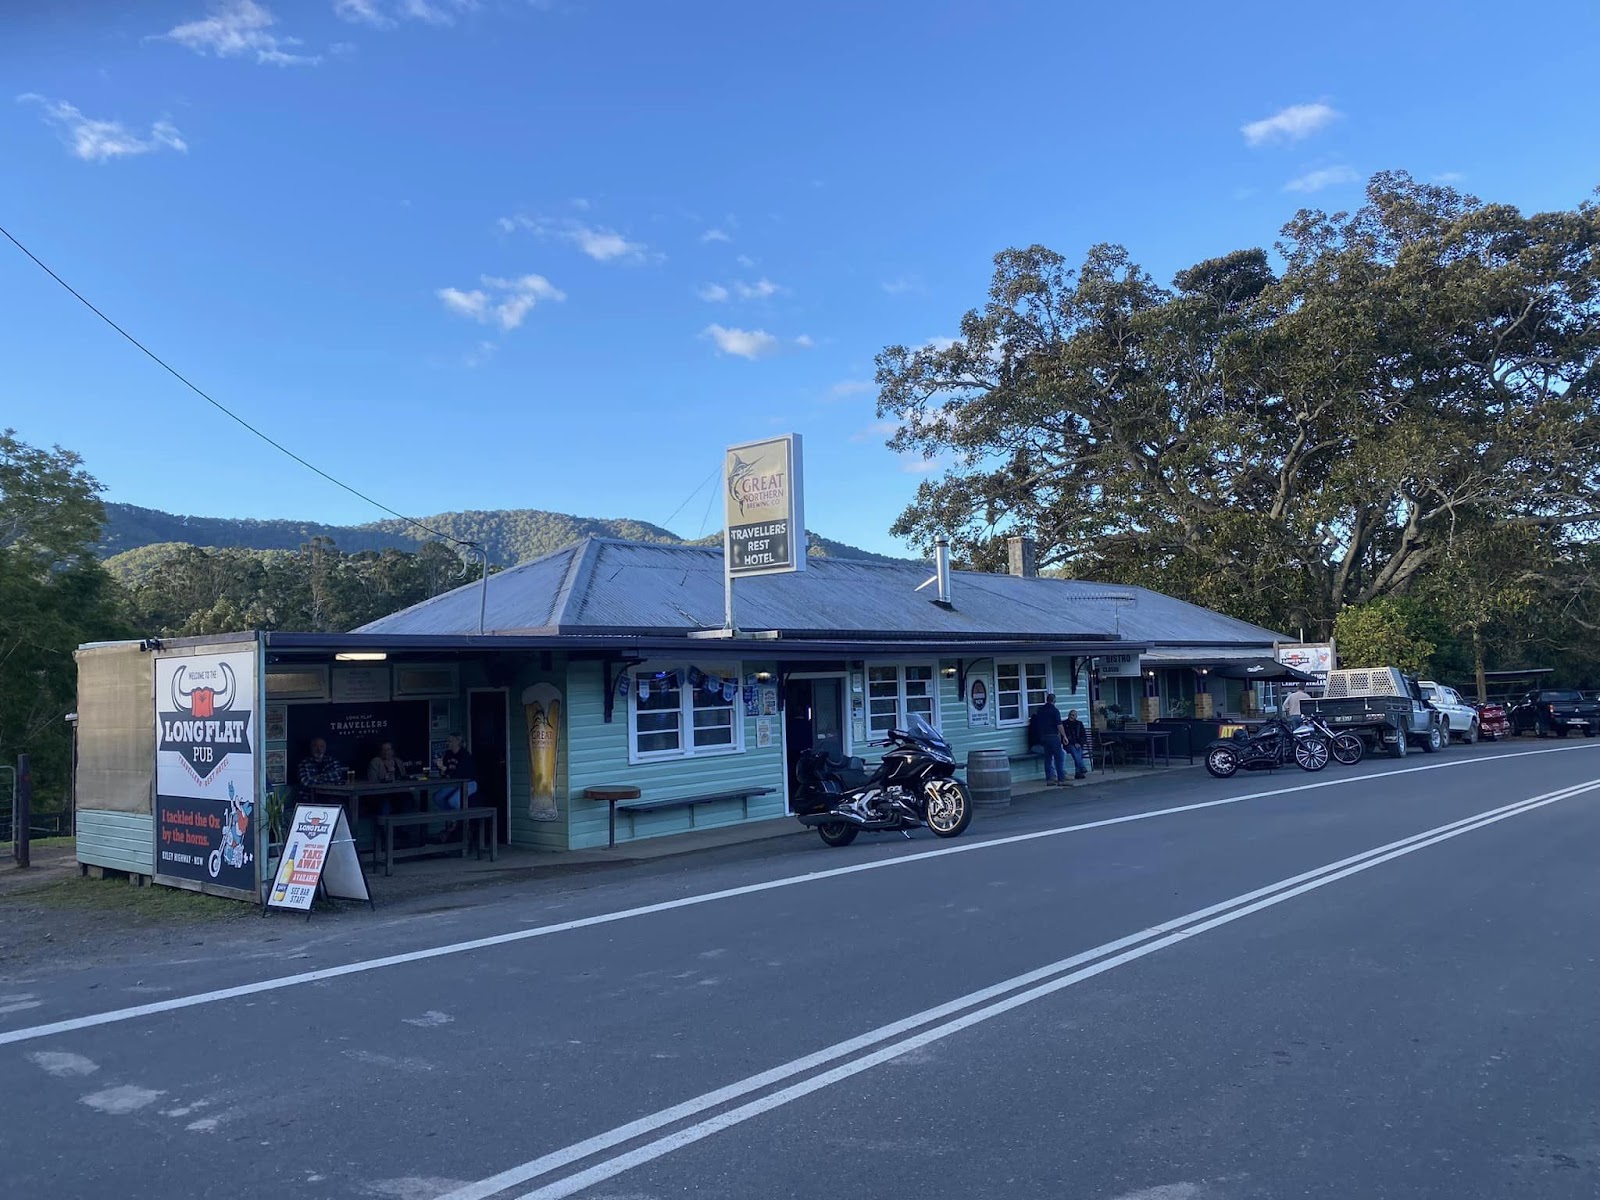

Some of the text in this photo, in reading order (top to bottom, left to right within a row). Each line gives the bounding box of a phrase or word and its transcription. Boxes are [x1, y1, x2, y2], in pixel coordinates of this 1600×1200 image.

[742, 473, 784, 494] GREAT
[743, 489, 784, 503] NORTHERN
[747, 500, 770, 510] BREWING
[731, 523, 786, 540] TRAVELLERS
[747, 539, 770, 552] REST
[744, 552, 774, 565] HOTEL
[1106, 654, 1131, 663] BISTRO
[188, 671, 204, 680] WELCOME
[205, 671, 210, 679] TO
[165, 720, 204, 742] LONG
[205, 720, 244, 743] FLAT
[330, 720, 388, 730] TRAVELLERS
[193, 746, 213, 762] PUB
[177, 755, 229, 787] TRAVELLERS REST HOTEL
[162, 809, 220, 828] I tackled the Ox
[299, 824, 314, 832] LONG
[162, 826, 210, 847] by the horns.
[174, 853, 191, 864] HIGHWAY
[194, 856, 204, 866] NSW
[302, 849, 324, 859] TAKE
[296, 859, 322, 869] AWAY
[291, 887, 300, 896] SEE
[300, 887, 310, 897] BAR
[290, 895, 306, 904] STAFF
